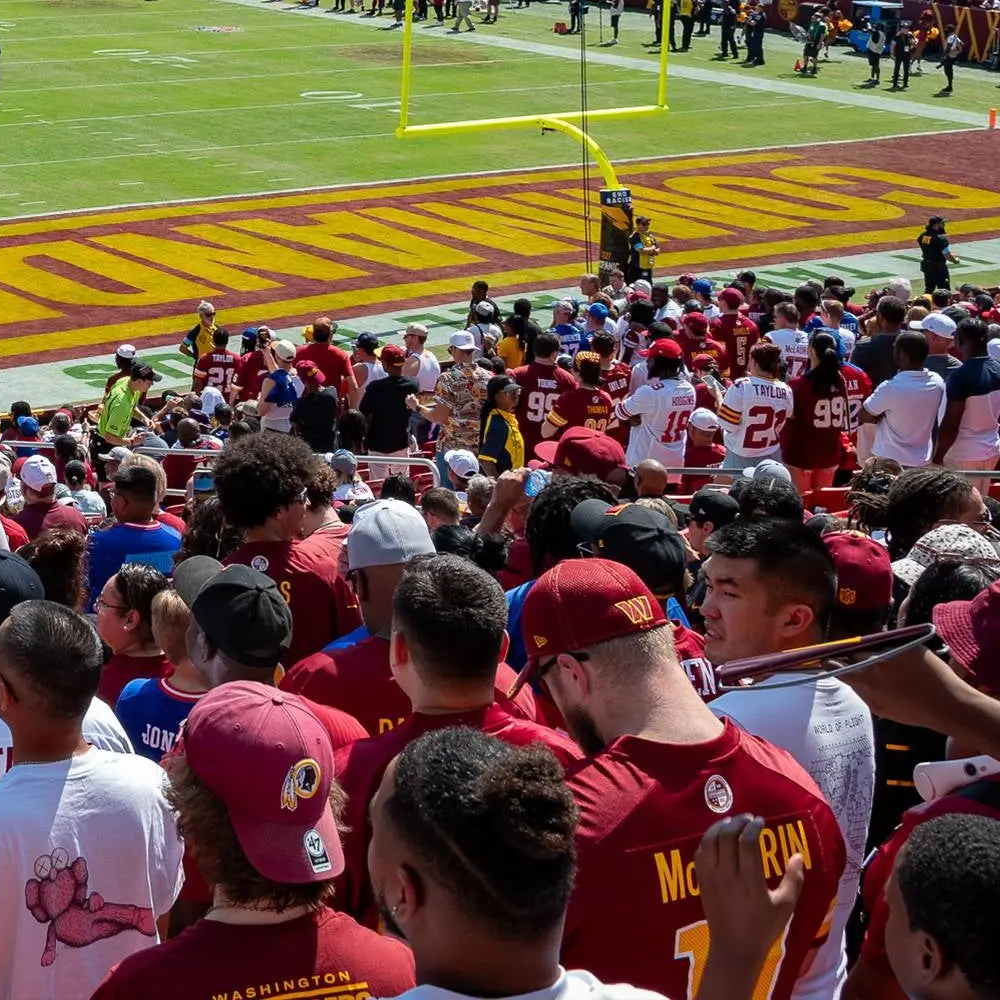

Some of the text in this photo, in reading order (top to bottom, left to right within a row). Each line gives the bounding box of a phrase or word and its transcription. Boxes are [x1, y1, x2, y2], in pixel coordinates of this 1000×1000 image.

[212, 354, 234, 362] TAYLOR
[736, 336, 747, 366] 5
[785, 344, 808, 353] McLAUR
[208, 367, 235, 392] 21
[537, 378, 558, 389] YOUNG
[608, 376, 628, 392] TAYLOR
[752, 384, 787, 400] TAYLOR
[587, 406, 608, 414] THOMAS
[671, 395, 695, 407] HODGINS
[813, 396, 844, 429] 99
[743, 405, 788, 449] 21
[614, 595, 653, 624] W
[142, 722, 180, 750] JON
[654, 820, 812, 904] McRIN
[212, 970, 351, 1000] WASHINGTON
